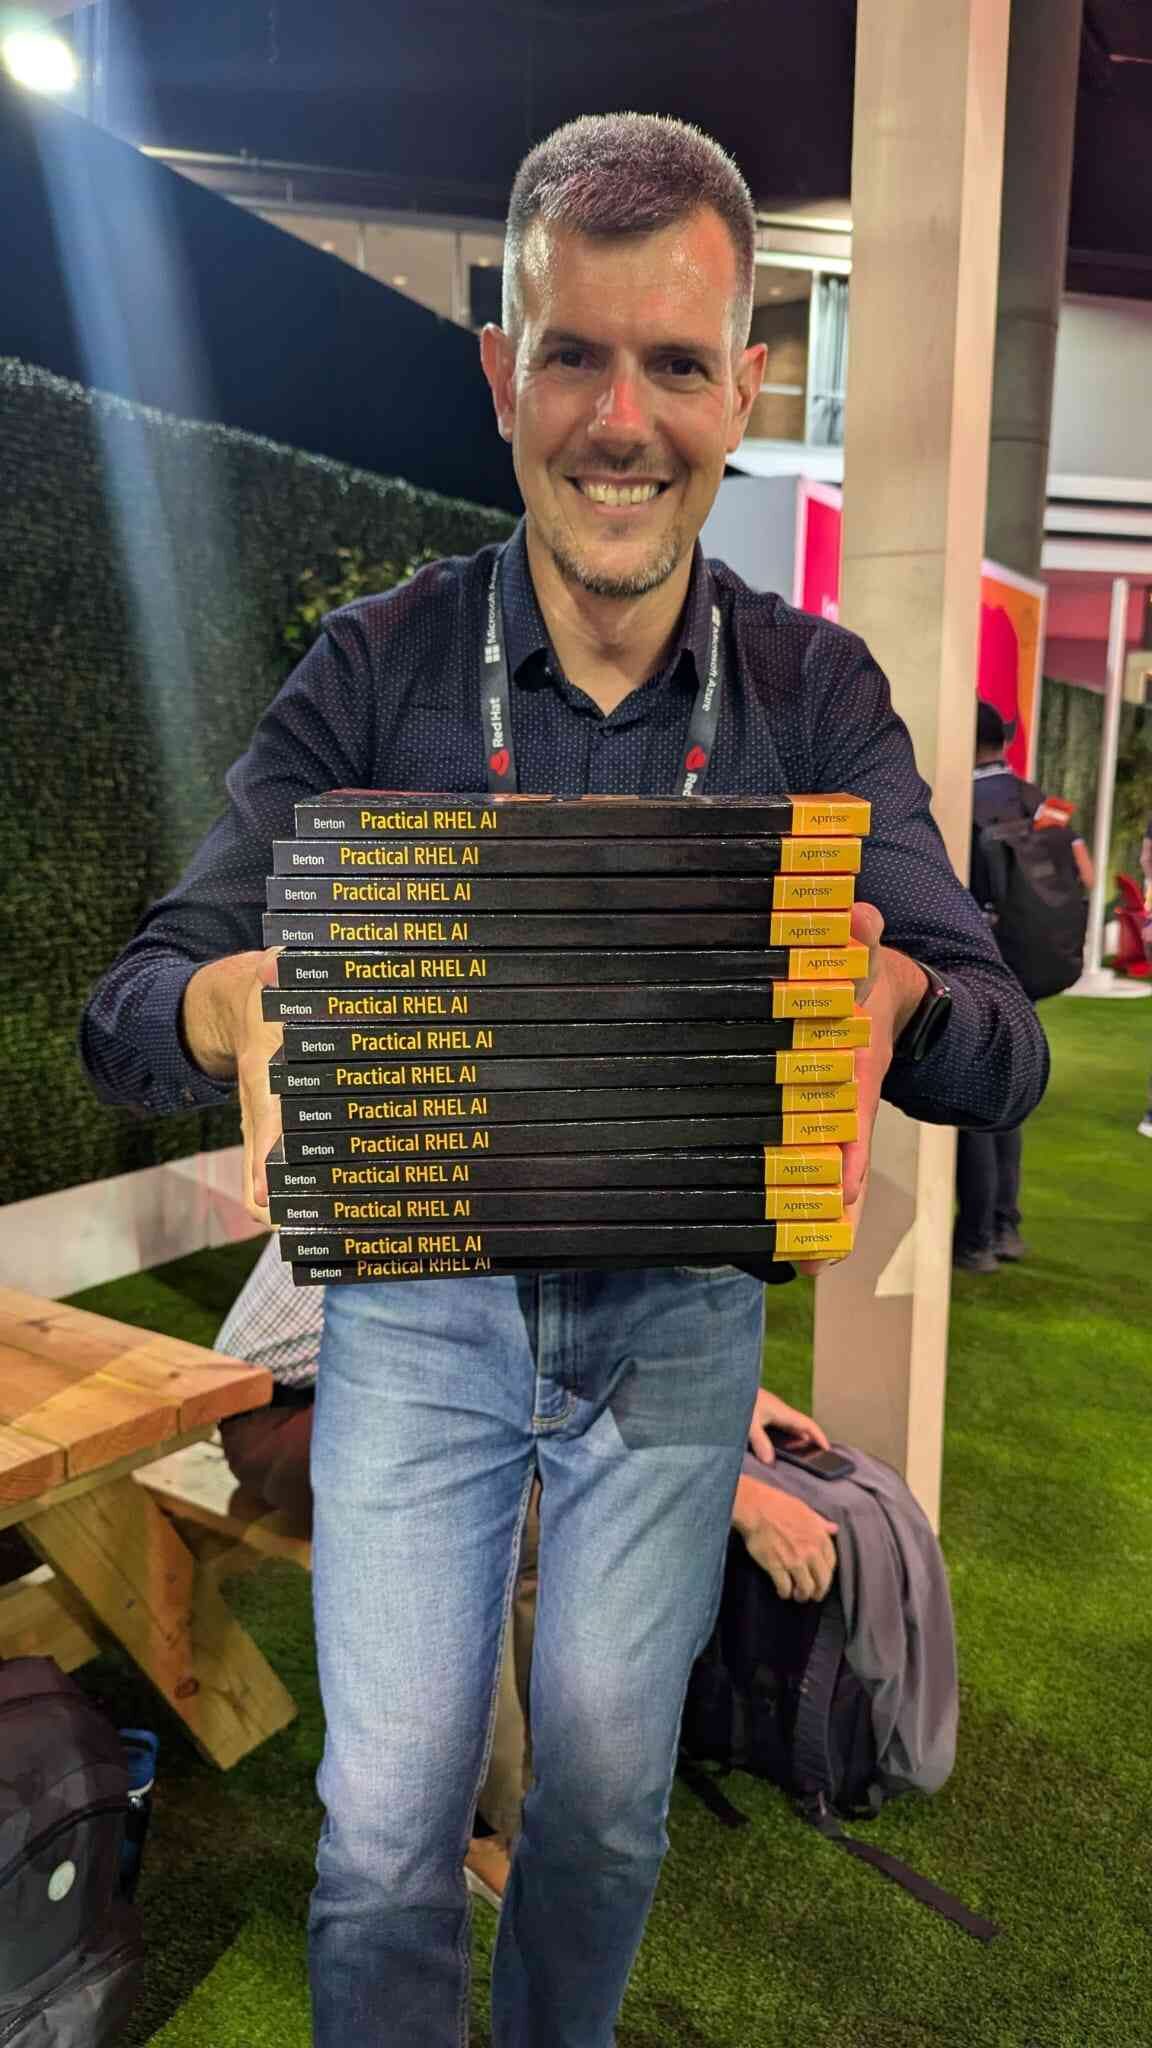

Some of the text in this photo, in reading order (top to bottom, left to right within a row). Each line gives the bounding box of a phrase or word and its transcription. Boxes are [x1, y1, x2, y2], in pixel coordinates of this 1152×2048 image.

[489, 697, 504, 748] Red Hat
[314, 811, 496, 829] Berton Practical RHEL AI
[292, 846, 478, 866] Berton Practical RHEL AI
[285, 882, 470, 901] Berton Practical RHEL AI
[282, 922, 467, 941] Berton Practical RHEL AI
[296, 959, 486, 979] Berton Practical RHEL AI
[280, 996, 467, 1014] Berton Practical RHEL AI
[302, 1031, 492, 1052] Berton Practical RHEL AI
[288, 1066, 476, 1086] Berton Practical RHEL AI
[299, 1098, 487, 1121] Berton Practical RHEL AI
[302, 1132, 488, 1155] Berton Practical RHEL AI
[285, 1165, 468, 1184] Berton Practical RHEL AI
[287, 1200, 469, 1218] Berton Practical RHEL AI
[298, 1236, 481, 1255] Berton Practical RHEL AI
[310, 1256, 491, 1279] Berton Practical RHEL AI
